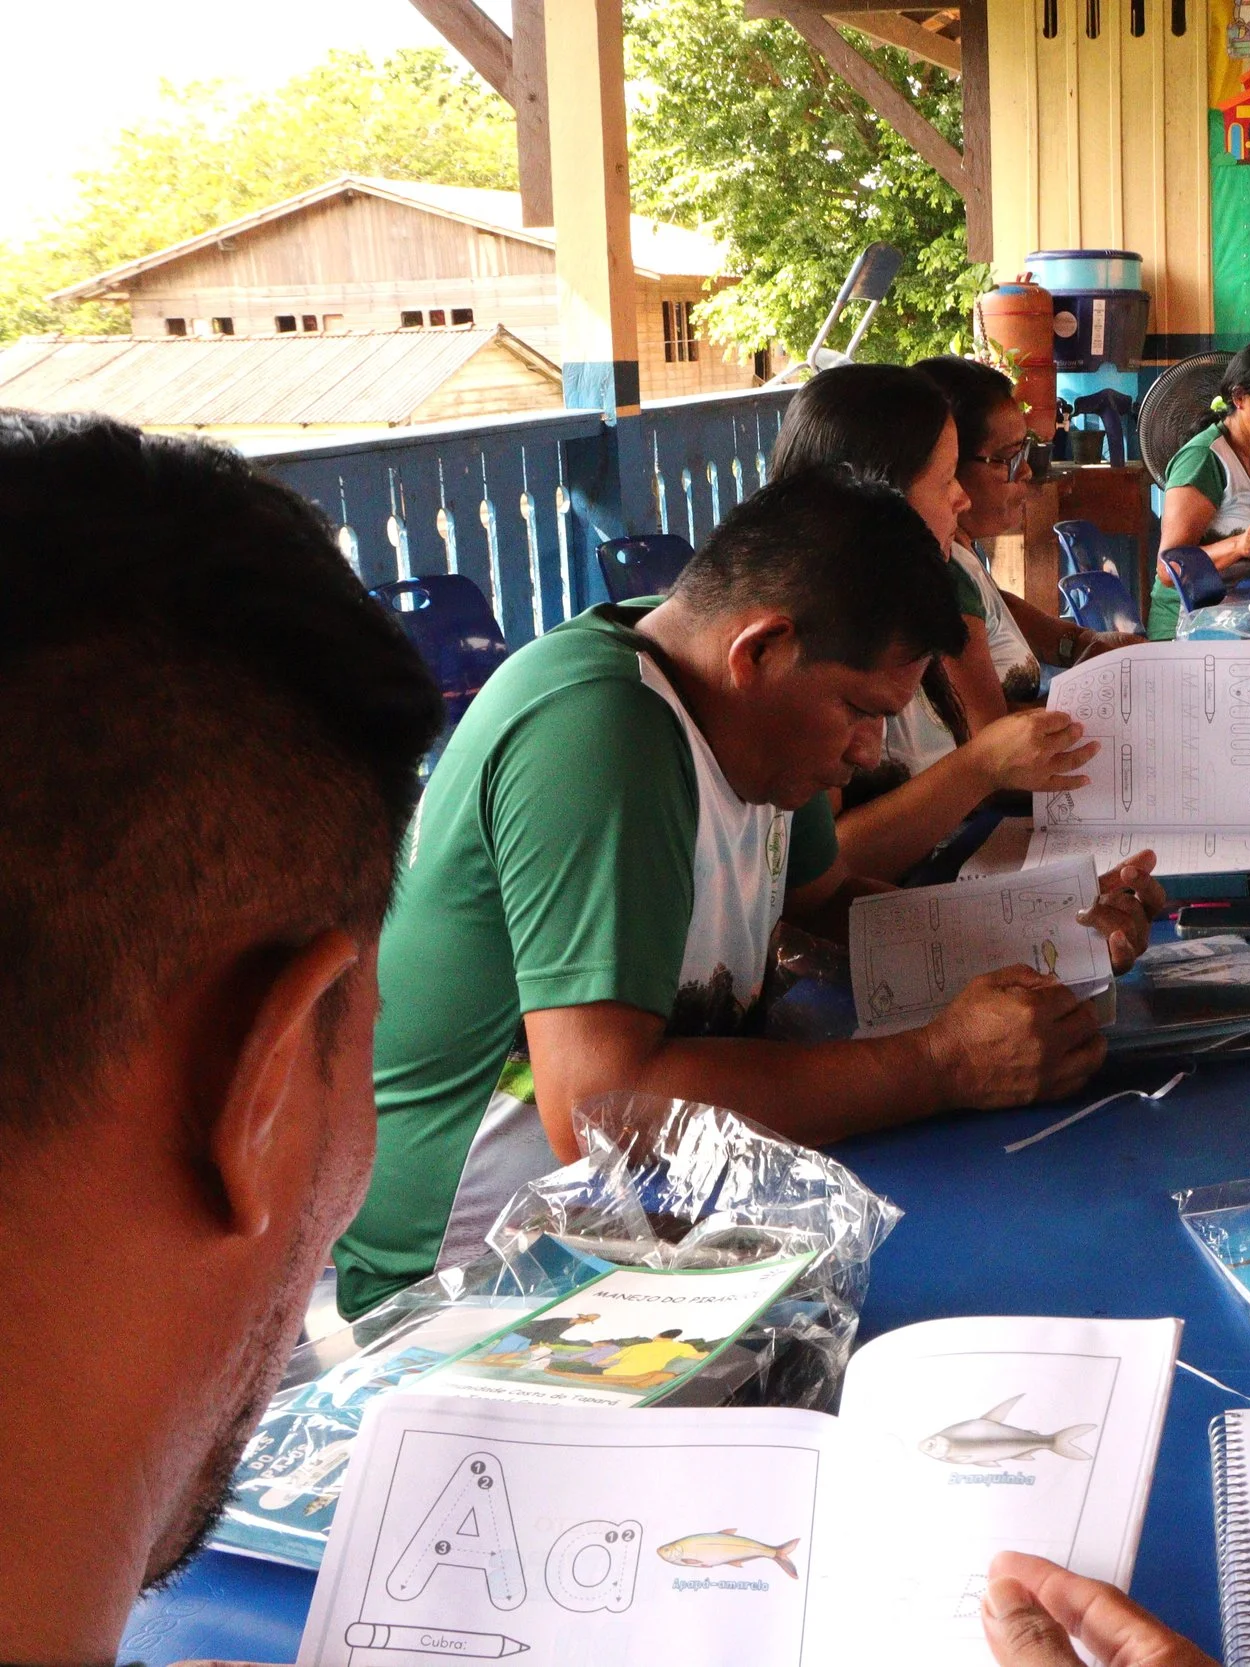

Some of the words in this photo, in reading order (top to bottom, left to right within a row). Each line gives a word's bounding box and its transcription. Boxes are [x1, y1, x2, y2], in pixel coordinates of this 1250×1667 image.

[593, 1290, 660, 1304] MANEJO
[661, 1296, 687, 1304] DO
[688, 1291, 762, 1304] PIRAR
[508, 1387, 546, 1398] Costa
[420, 1634, 467, 1651] Cubra:
